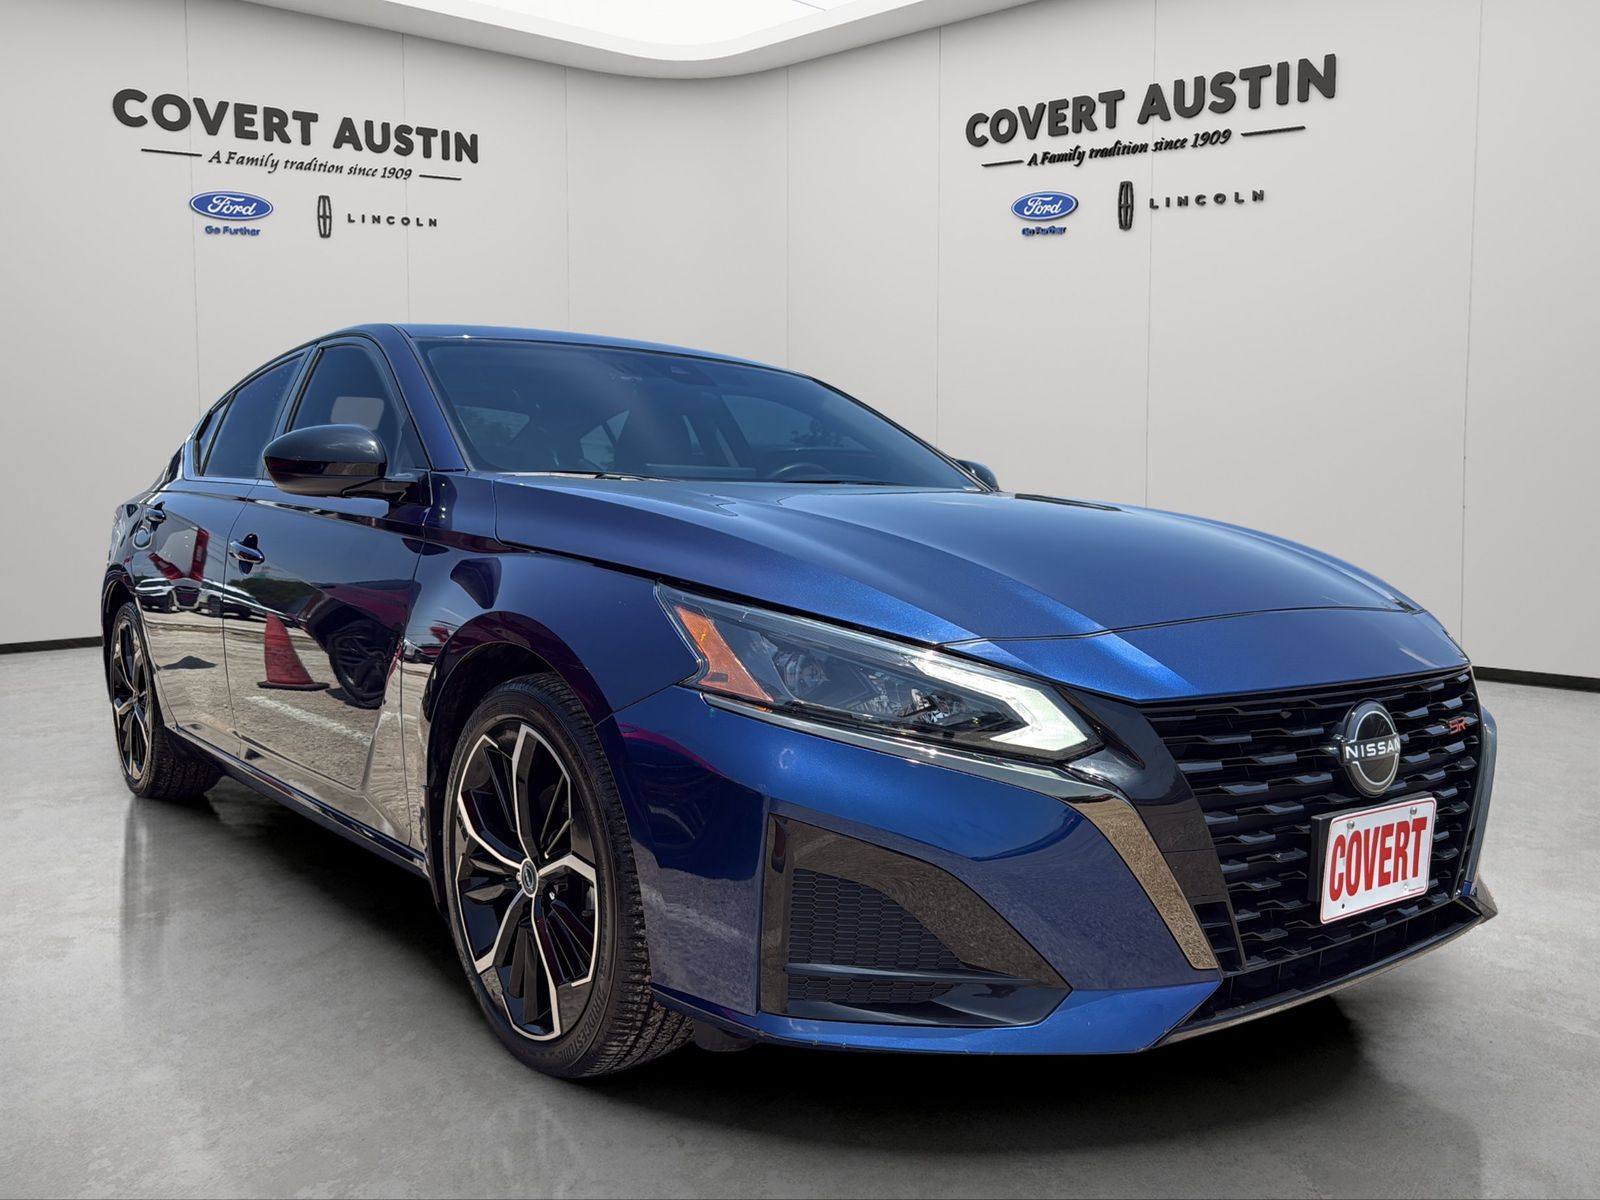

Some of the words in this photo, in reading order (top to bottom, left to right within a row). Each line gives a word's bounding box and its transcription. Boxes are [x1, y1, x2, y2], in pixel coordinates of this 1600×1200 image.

[965, 88, 1126, 149] COVERT
[1136, 53, 1337, 126] AUSTIN
[112, 88, 319, 147] COVERT
[332, 116, 479, 164] AUSTIN
[1026, 152, 1039, 167] A
[1039, 144, 1087, 168] Family
[1088, 139, 1149, 160] tradition
[1151, 136, 1189, 153] since
[1191, 128, 1233, 149] 1909
[207, 150, 222, 164] A
[224, 151, 280, 174] Family
[283, 156, 344, 174] tradition
[346, 163, 379, 178] since
[380, 166, 413, 181] 1909
[207, 195, 257, 216] Ford
[1023, 196, 1064, 216] Ford
[1149, 189, 1265, 211] LINCOLN
[204, 225, 222, 235] Go
[222, 225, 261, 236] Further
[347, 213, 438, 228] LINCOLN
[1448, 716, 1468, 735] SR
[1344, 735, 1401, 760] NISSAN
[1329, 816, 1428, 902] COVERT
